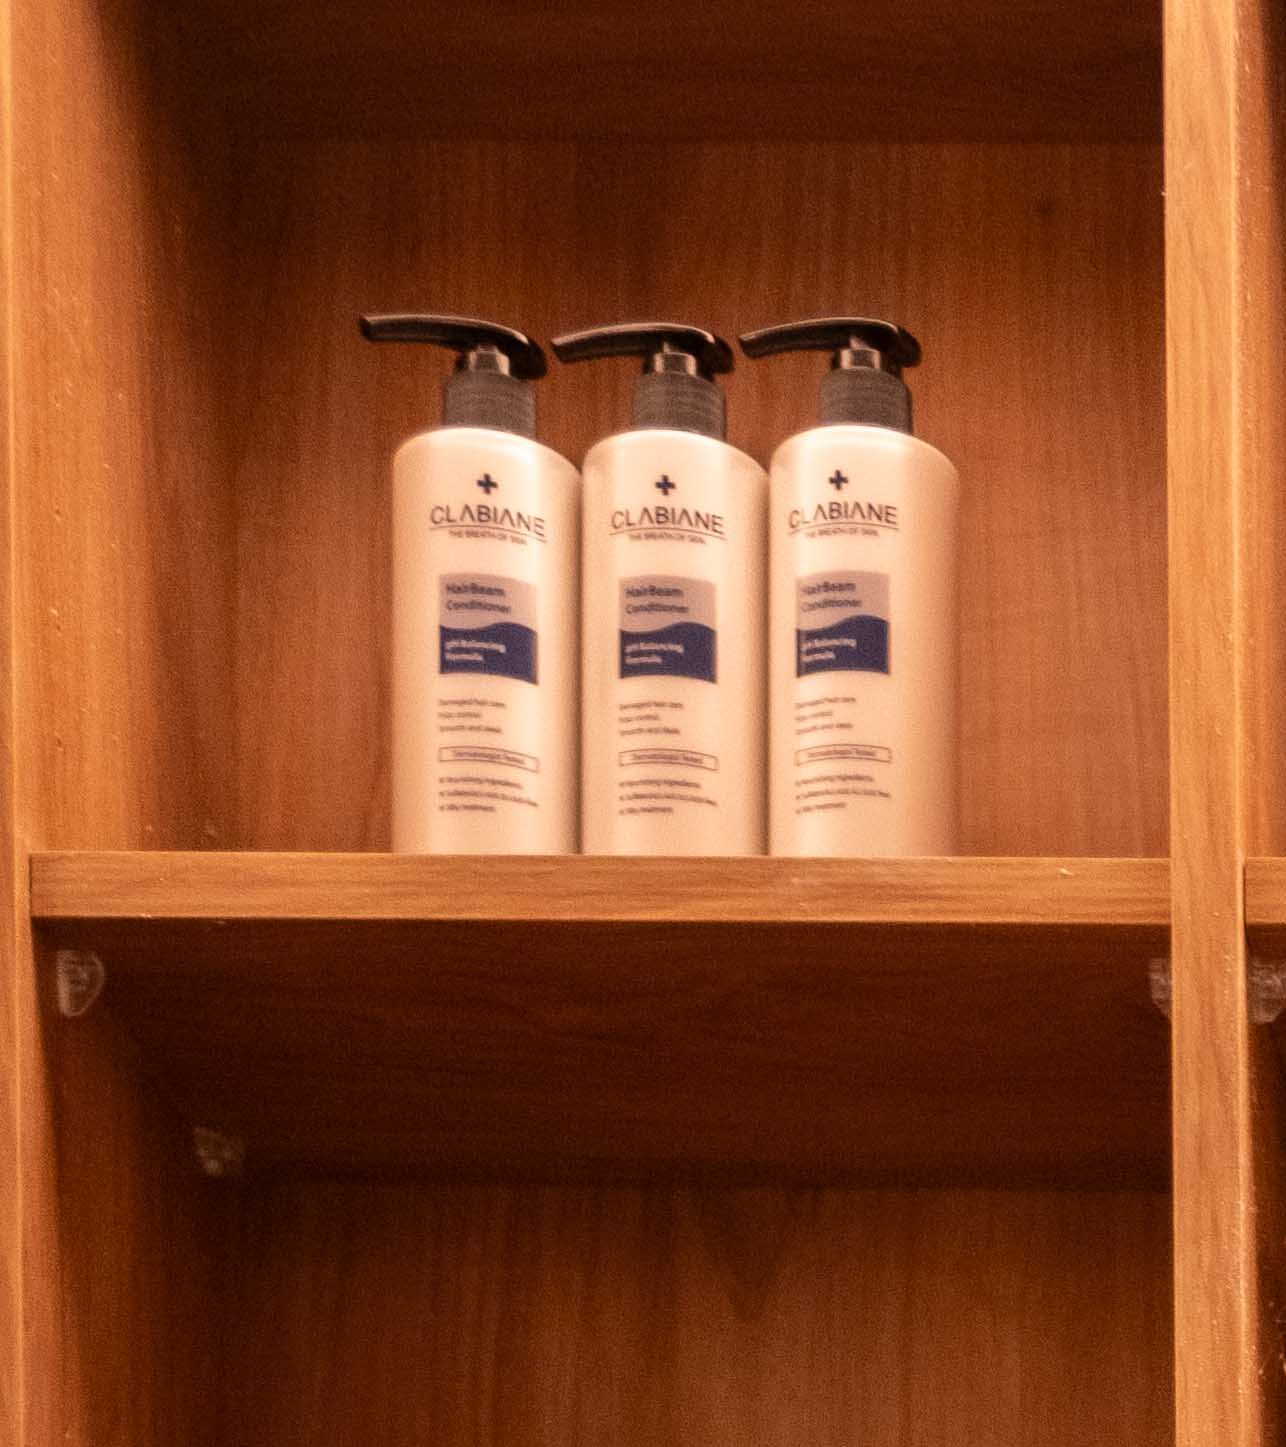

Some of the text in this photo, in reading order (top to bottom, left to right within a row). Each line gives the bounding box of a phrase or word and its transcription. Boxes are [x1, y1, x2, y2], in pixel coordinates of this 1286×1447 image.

[430, 504, 546, 536] CLABIANE
[611, 504, 724, 534] CLABIANE
[788, 501, 898, 527] CLABIANE
